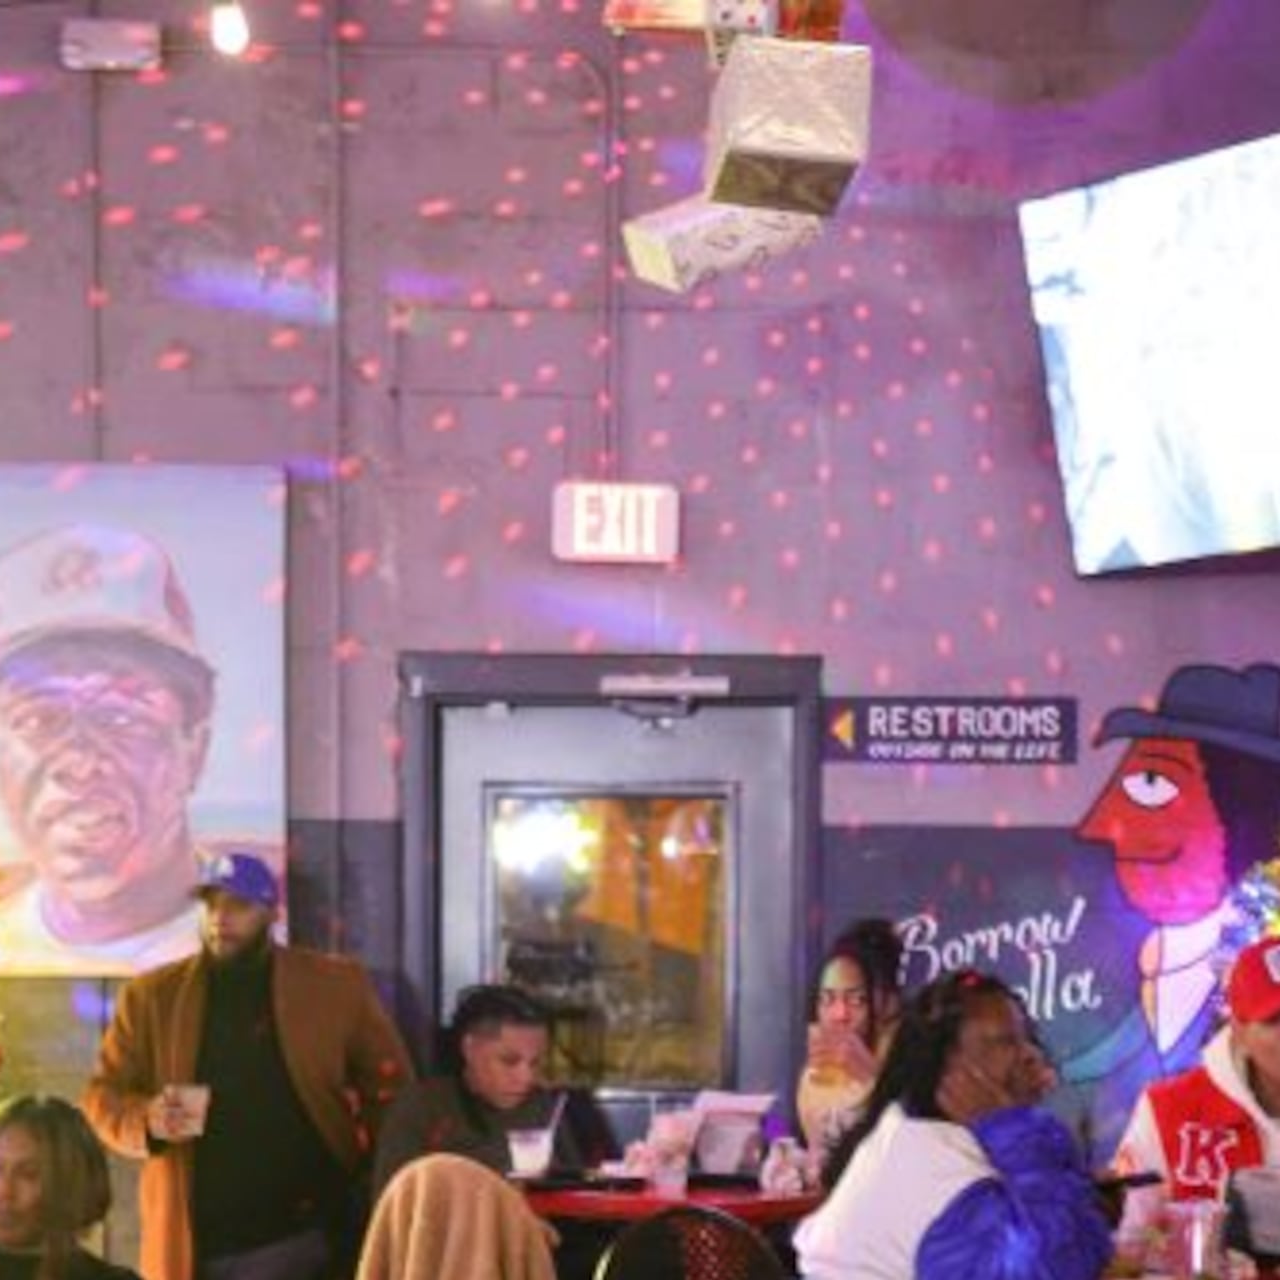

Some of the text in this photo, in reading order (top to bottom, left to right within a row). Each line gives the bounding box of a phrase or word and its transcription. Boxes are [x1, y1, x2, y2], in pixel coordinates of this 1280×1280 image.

[573, 485, 664, 555] EXIT
[868, 705, 1061, 737] RESTROOMS
[1176, 1121, 1239, 1187] K
